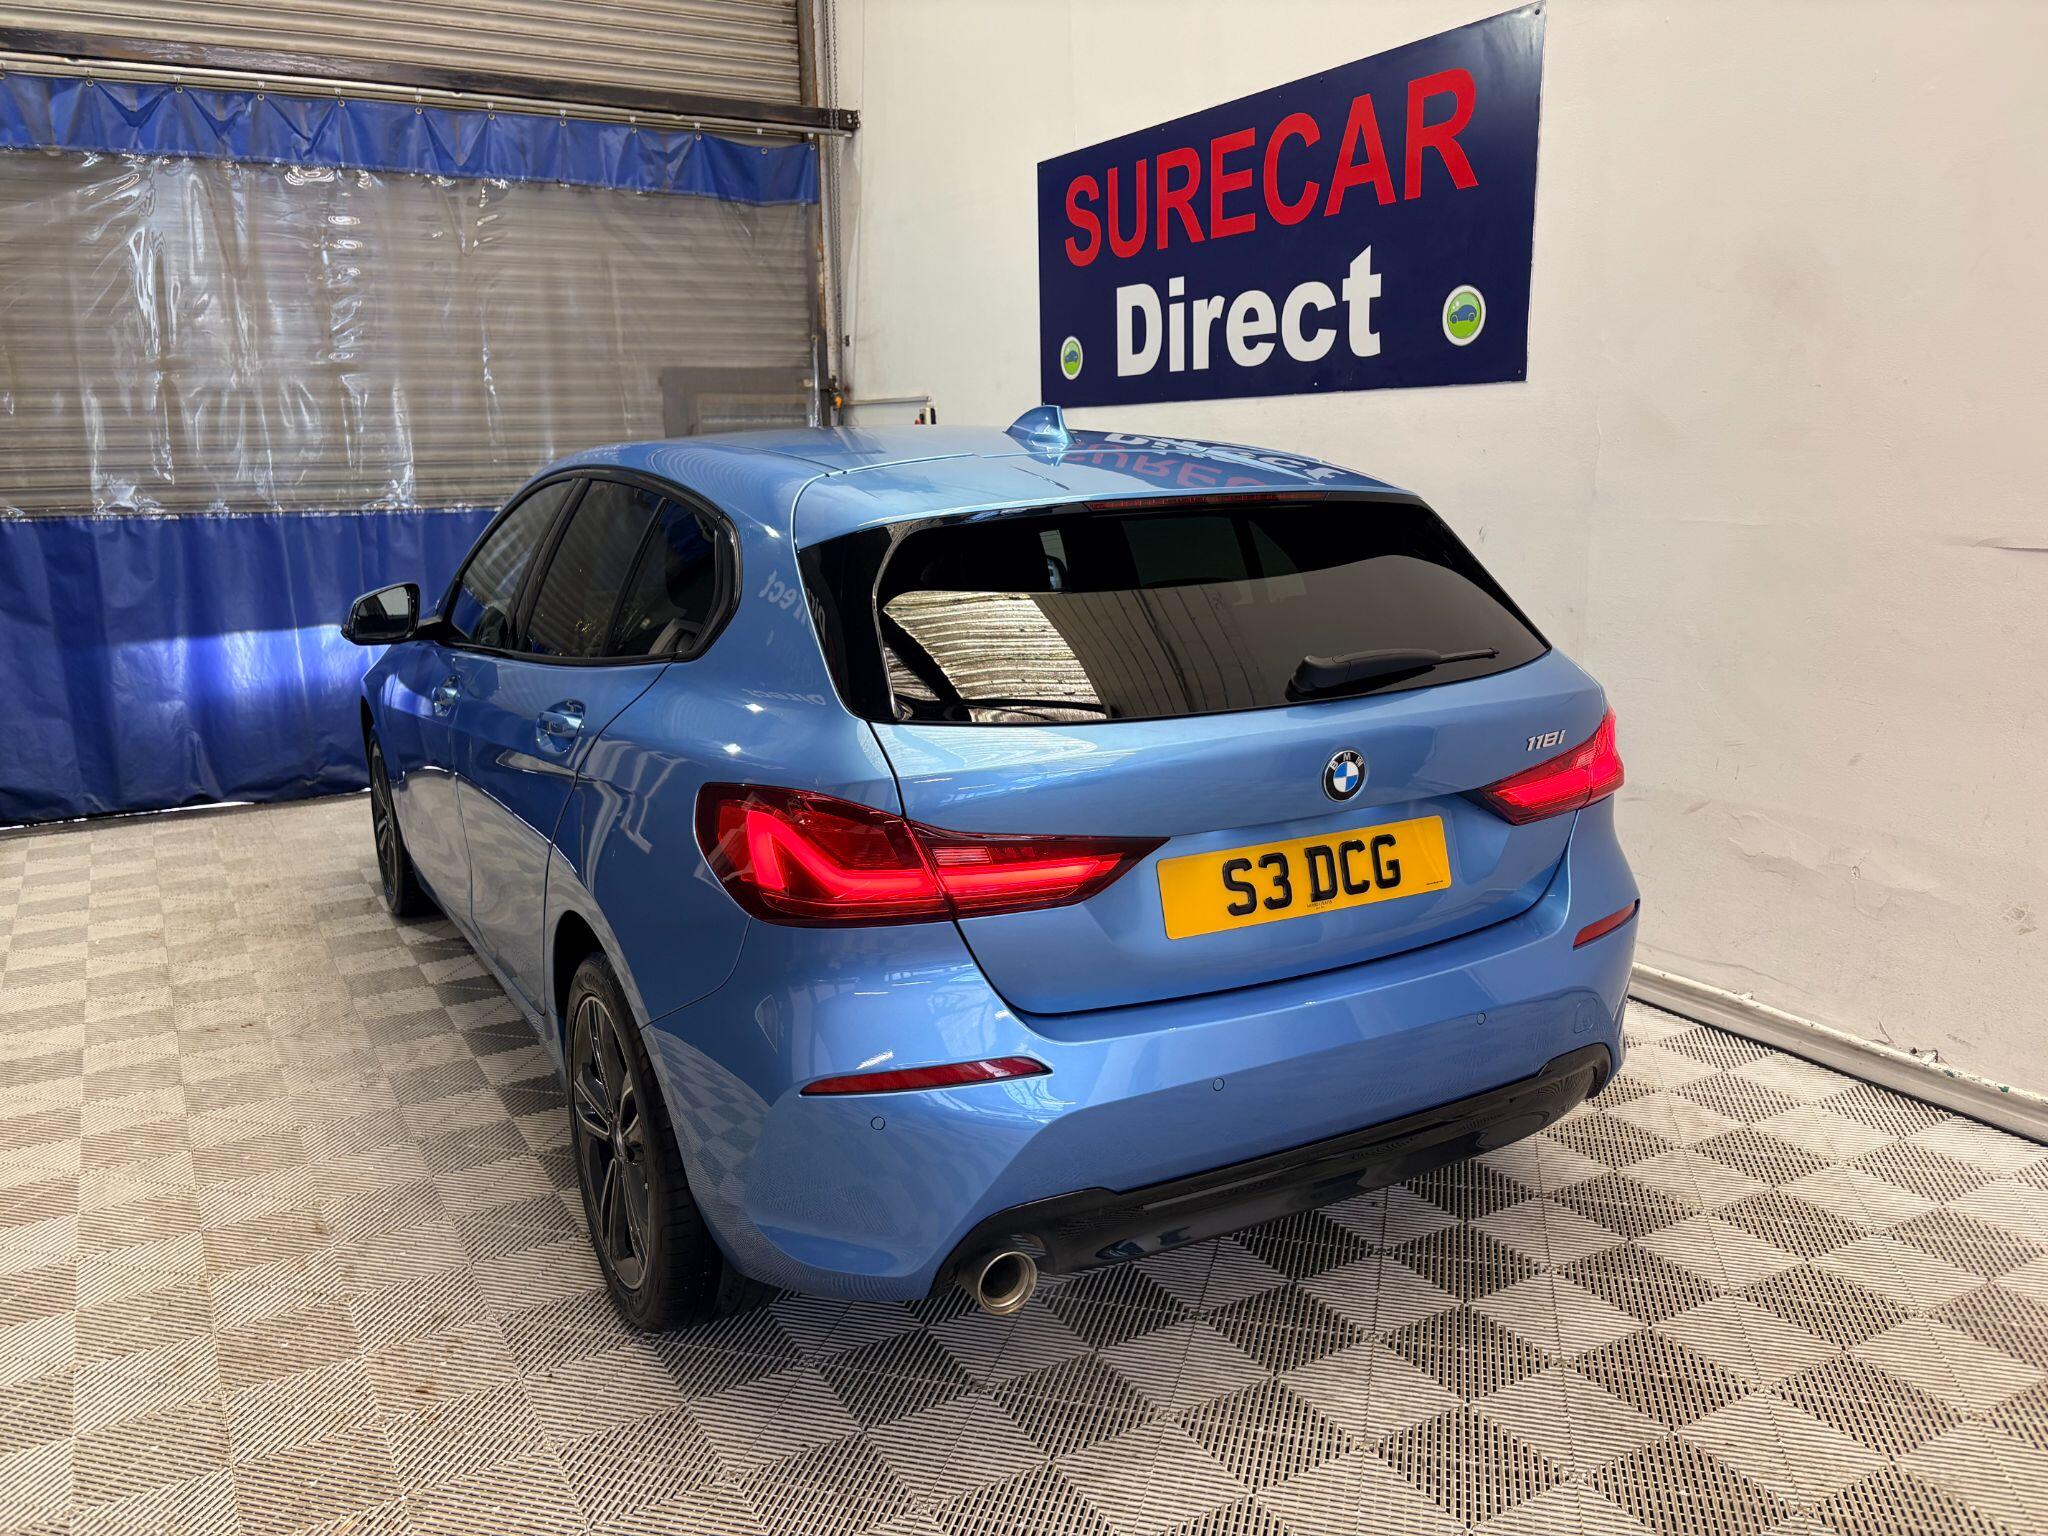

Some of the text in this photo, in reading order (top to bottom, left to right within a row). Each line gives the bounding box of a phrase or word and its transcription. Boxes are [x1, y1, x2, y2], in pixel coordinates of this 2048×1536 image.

[1064, 67, 1479, 267] SURECAR
[1116, 245, 1382, 377] Direct
[1329, 752, 1364, 770] BMW
[1526, 729, 1566, 751] 118i
[1222, 834, 1402, 916] S3 DCG
